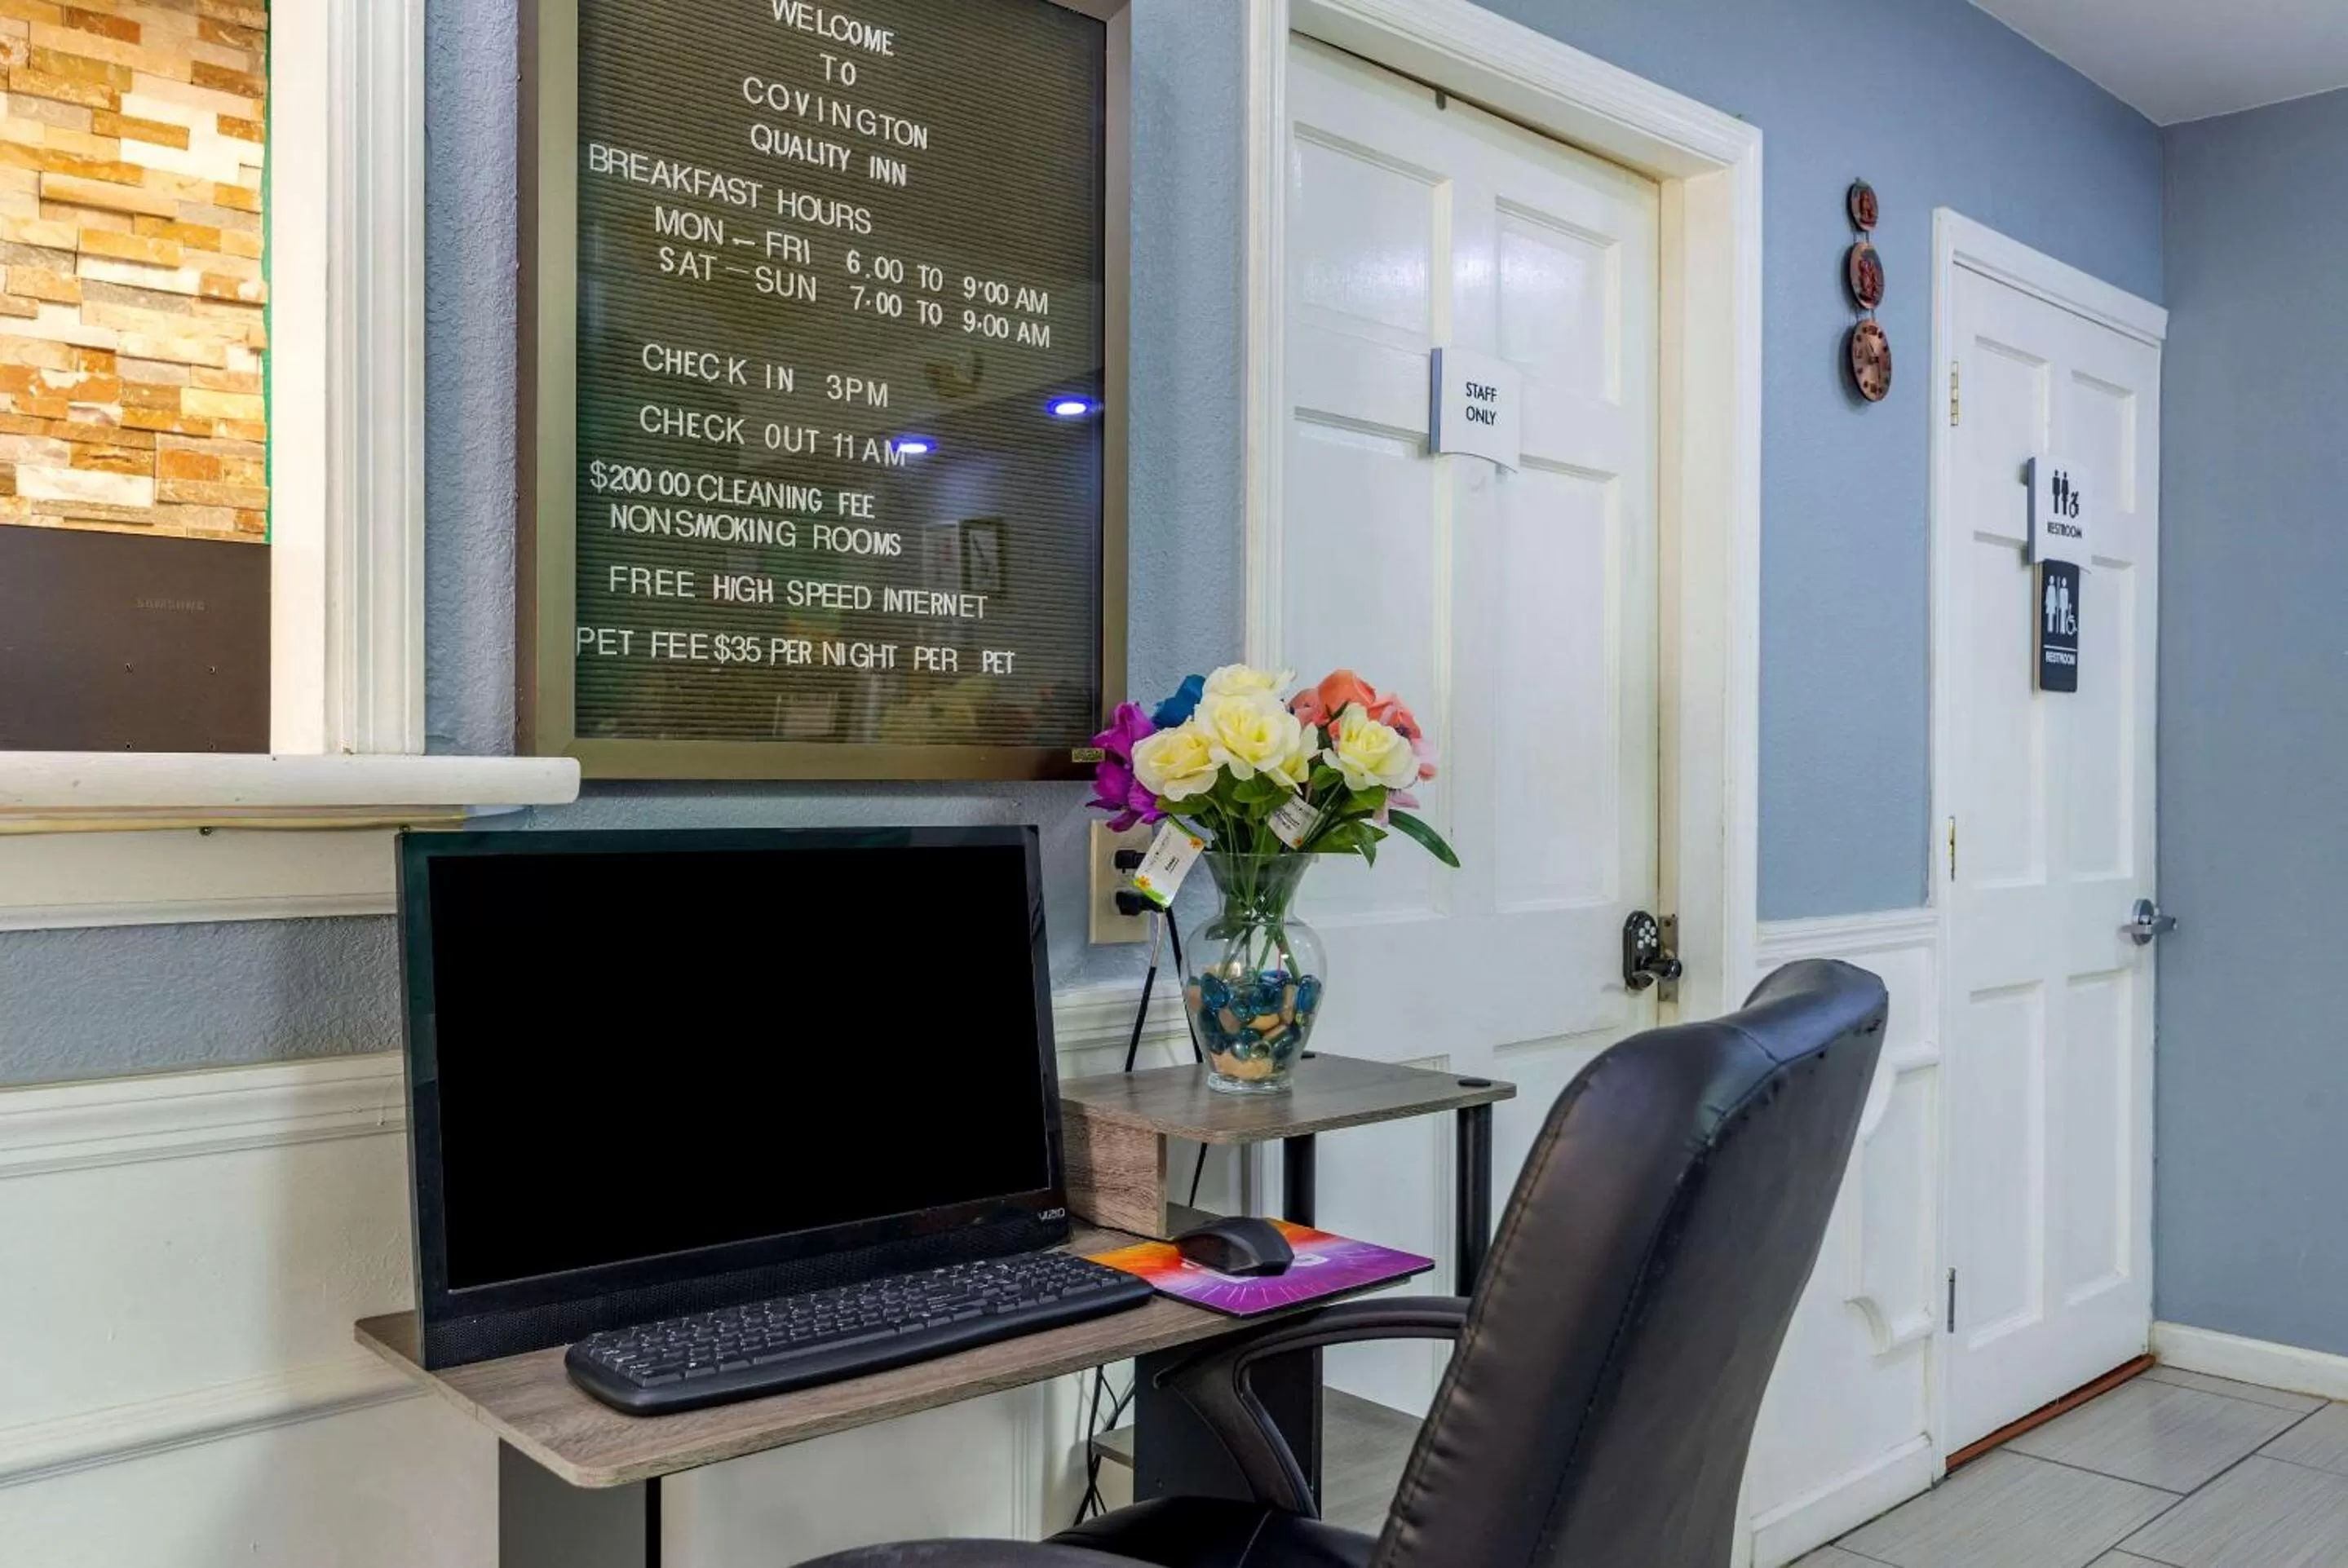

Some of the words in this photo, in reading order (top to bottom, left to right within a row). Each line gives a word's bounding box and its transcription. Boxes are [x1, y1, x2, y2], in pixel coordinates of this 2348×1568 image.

[772, 0, 895, 56] WELCOME
[820, 53, 856, 86] TO
[743, 77, 927, 149] COVINGTON
[750, 125, 851, 173] QUALITY
[869, 156, 907, 186] INN
[589, 144, 763, 209] BREAKFAST
[777, 188, 871, 235] HOURS
[655, 206, 723, 245] MON
[766, 231, 810, 265] FRI
[917, 264, 943, 292] TO
[1015, 287, 1048, 315] AM
[659, 247, 717, 281] SAT
[755, 266, 816, 302] SUN
[917, 299, 943, 325] TO
[1017, 321, 1050, 348] AM
[643, 343, 747, 386] CHECK
[766, 364, 794, 393] IN
[826, 374, 888, 408] 3PM
[1466, 381, 1497, 403] STAFF
[639, 406, 745, 444] CHECK
[765, 423, 820, 453] OUT
[1466, 405, 1497, 426] ONLY
[697, 474, 822, 514] CLEANING
[838, 492, 875, 519] FEE
[814, 525, 901, 556] ROOMS
[610, 566, 696, 598] FREE
[714, 575, 774, 604] HIGH
[787, 580, 871, 611] SPEED
[883, 585, 988, 619] INTERNET
[577, 626, 635, 656] PET
[652, 631, 709, 659] FEE
[714, 633, 761, 664] $35
[770, 638, 812, 665] PER
[822, 641, 898, 669] NIGHT
[913, 645, 958, 673] PER
[982, 650, 1015, 674] PET
[2045, 651, 2076, 666] RESTROOM
